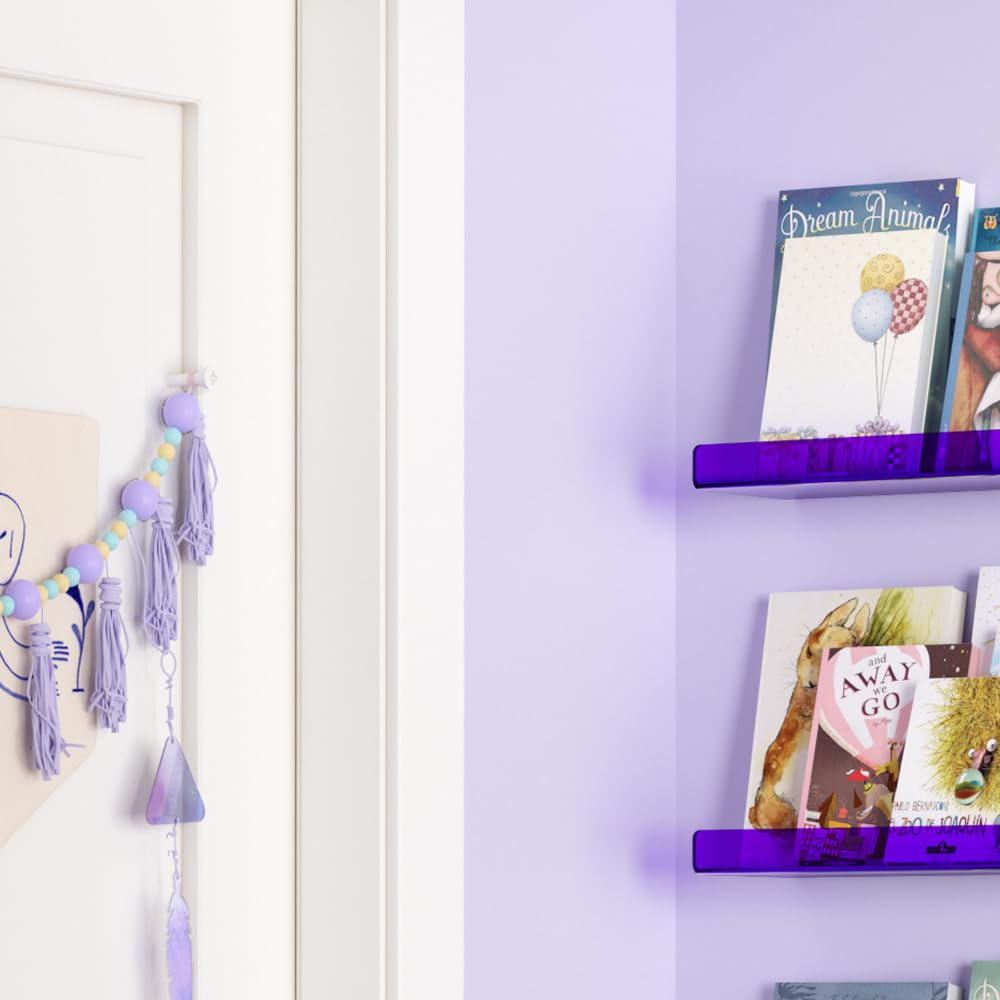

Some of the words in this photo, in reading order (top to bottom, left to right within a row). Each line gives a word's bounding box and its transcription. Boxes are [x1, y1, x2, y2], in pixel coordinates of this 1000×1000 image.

[781, 204, 857, 239] Dream
[868, 653, 887, 666] and
[841, 661, 917, 699] AWAY
[873, 686, 888, 695] we
[861, 692, 900, 716] GO
